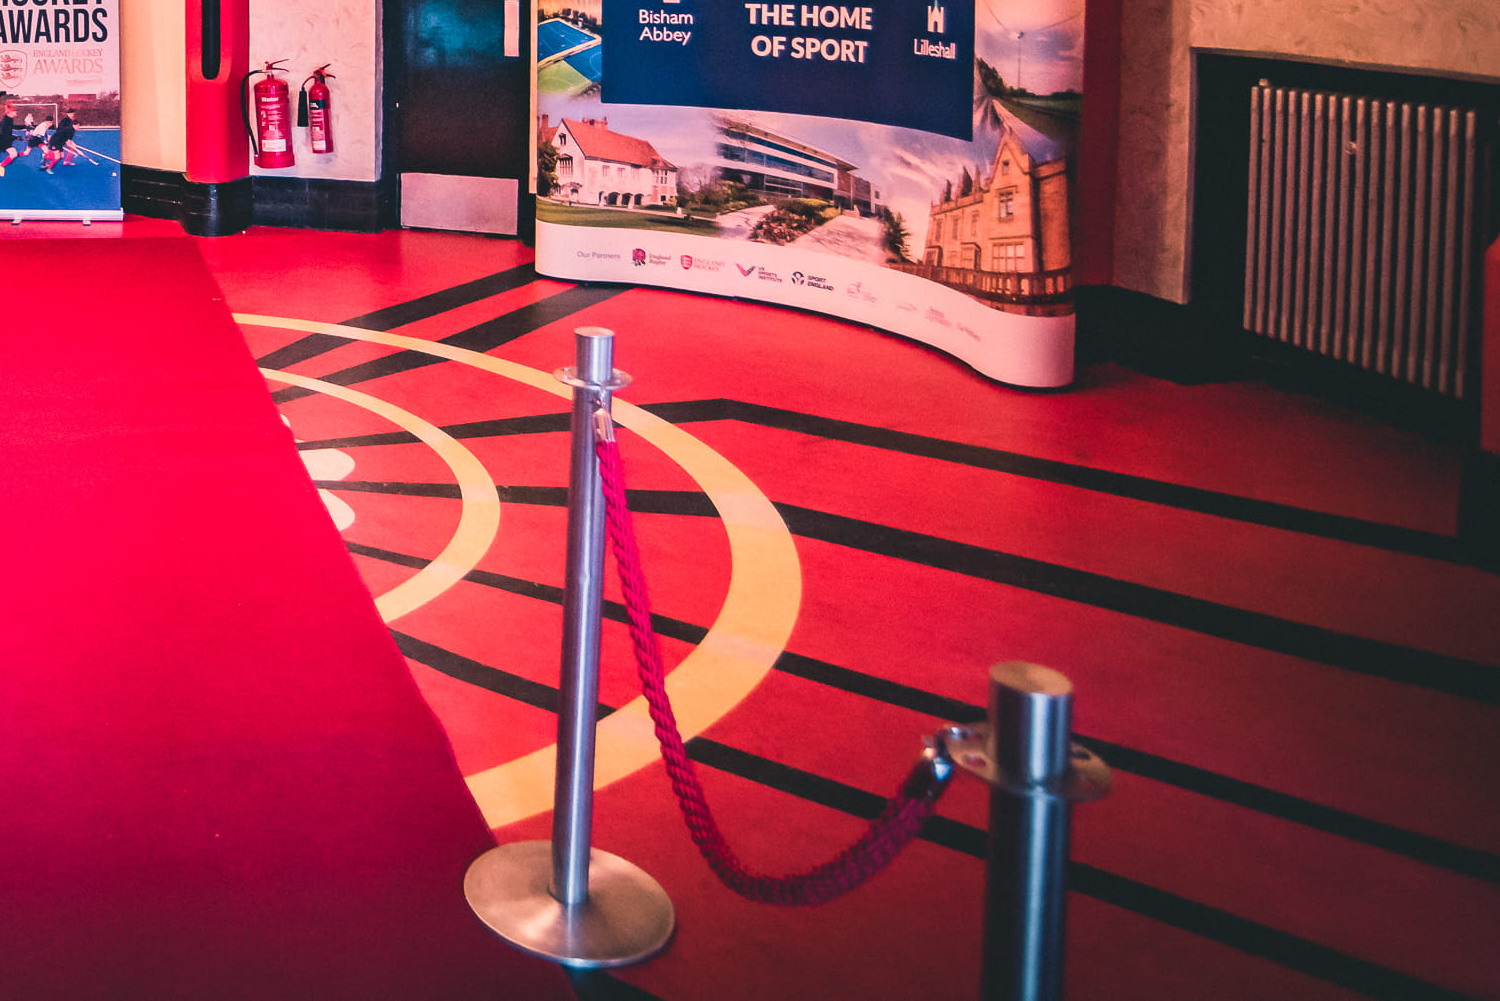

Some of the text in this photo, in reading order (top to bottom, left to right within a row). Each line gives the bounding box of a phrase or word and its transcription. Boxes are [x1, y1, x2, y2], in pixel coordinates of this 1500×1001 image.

[638, 8, 694, 25] Bisham
[744, 3, 873, 30] THE HOME
[638, 26, 692, 47] Abbey
[750, 35, 868, 63] OF SPORT
[913, 38, 956, 60] Lilleshall
[33, 58, 103, 75] AWARDS
